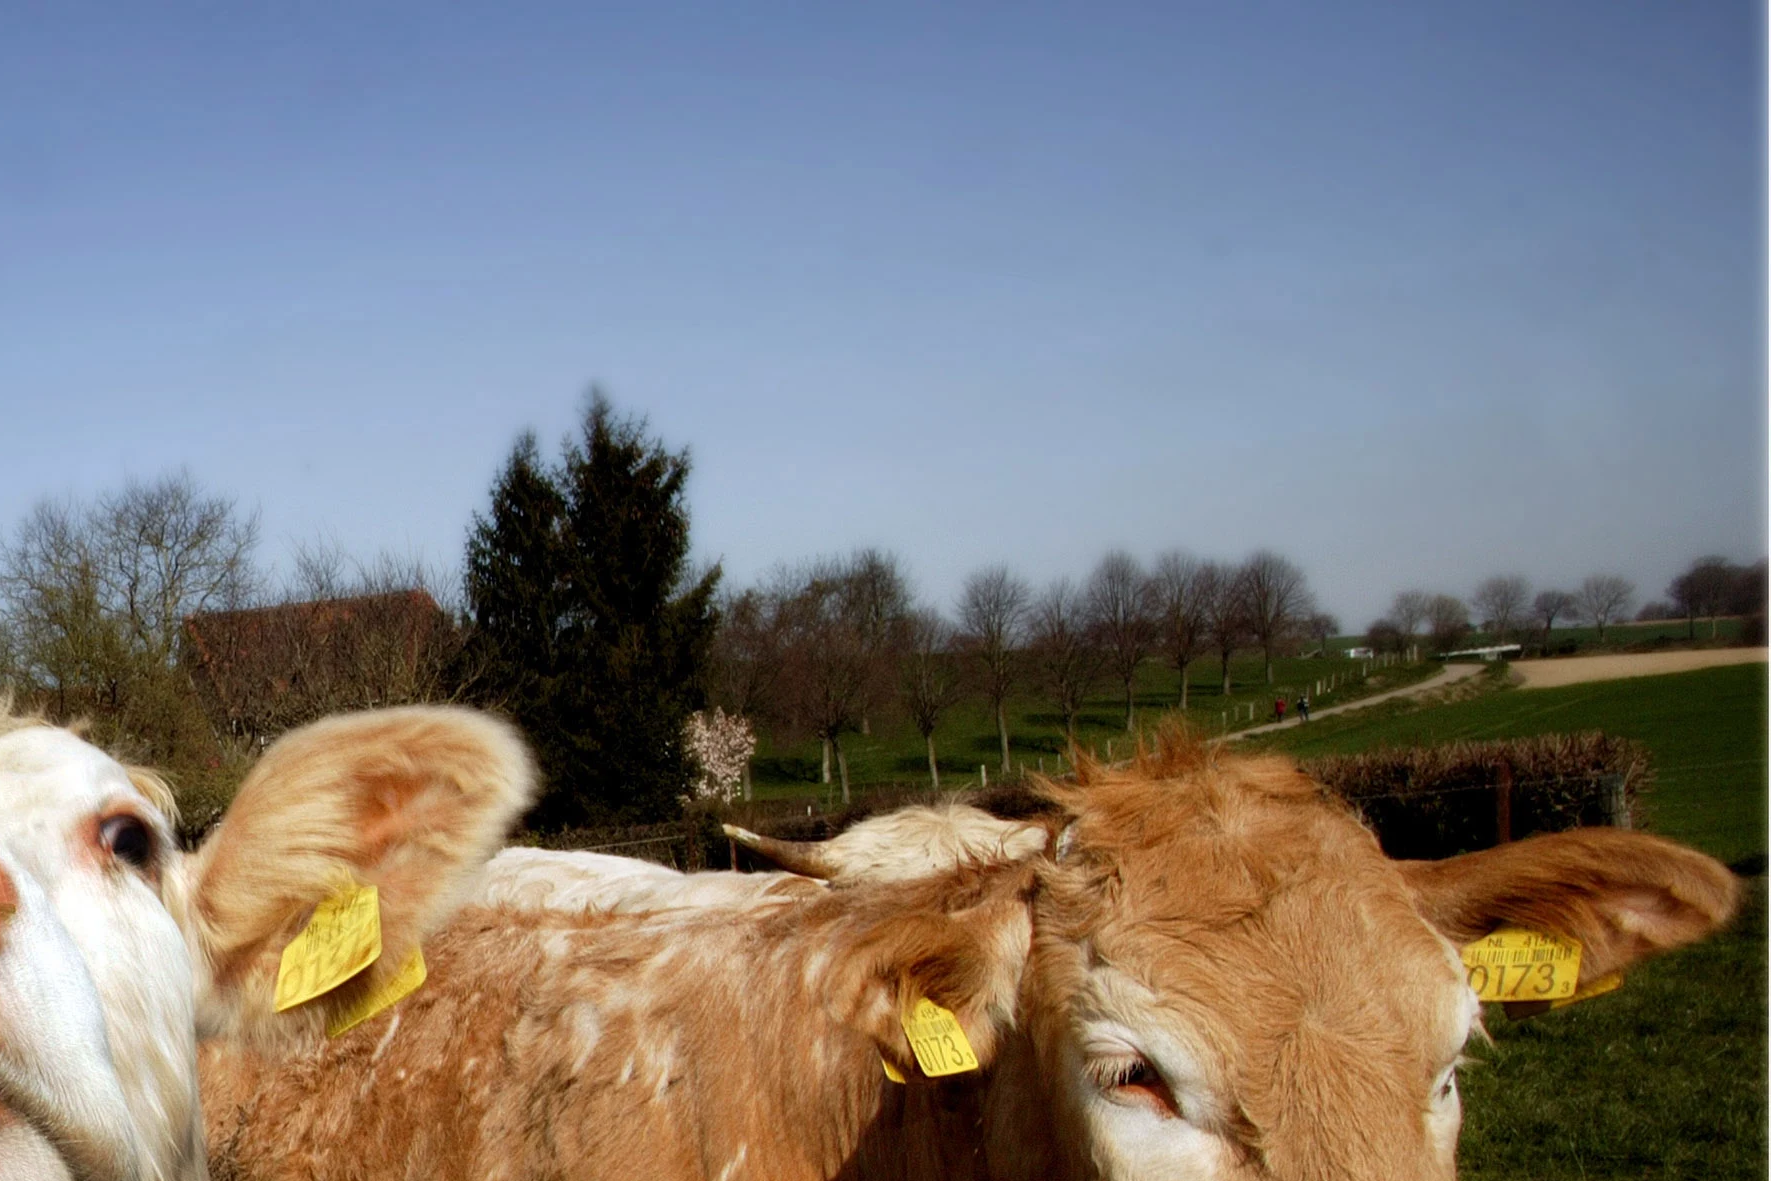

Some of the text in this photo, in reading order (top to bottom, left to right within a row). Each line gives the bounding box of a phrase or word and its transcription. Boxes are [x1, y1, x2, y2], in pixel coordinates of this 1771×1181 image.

[1488, 937, 1505, 948] NL
[1466, 963, 1569, 996] 0173 3
[916, 1034, 964, 1071] 0173
